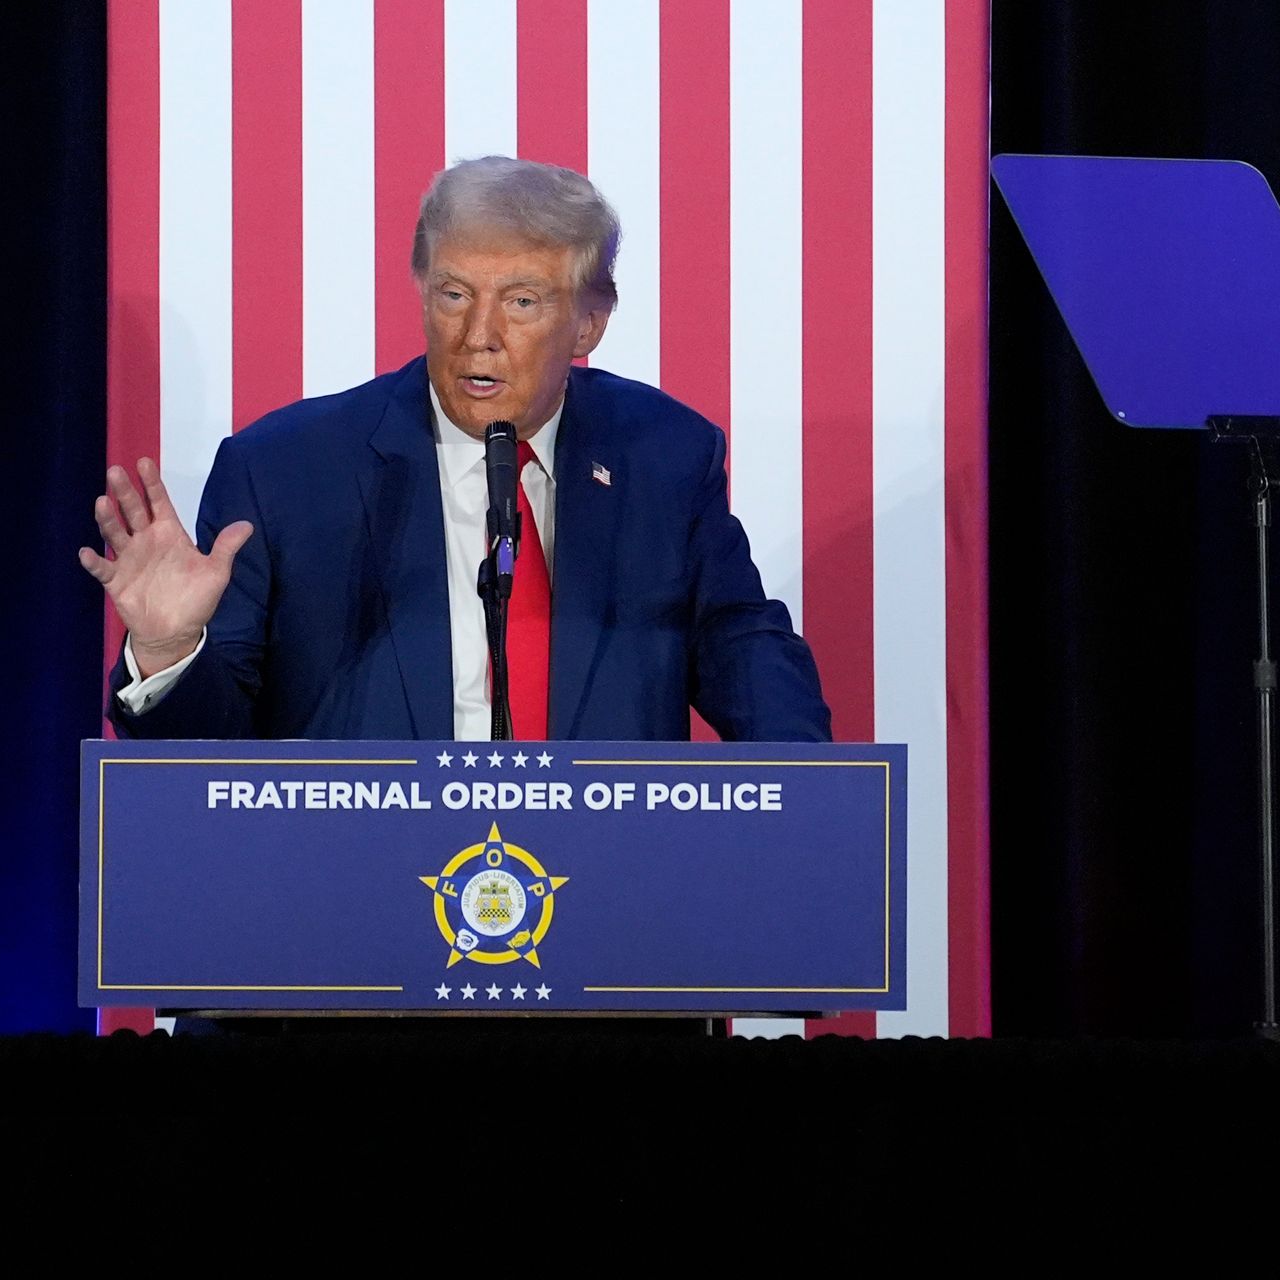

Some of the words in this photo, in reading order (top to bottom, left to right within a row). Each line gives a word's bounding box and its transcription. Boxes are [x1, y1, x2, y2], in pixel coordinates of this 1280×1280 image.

[207, 780, 433, 811] FRATERNAL
[441, 781, 574, 812] ORDER
[583, 782, 636, 812] OF
[645, 782, 784, 813] POLICE
[442, 881, 459, 898] F
[486, 848, 503, 868] O
[527, 882, 545, 897] P
